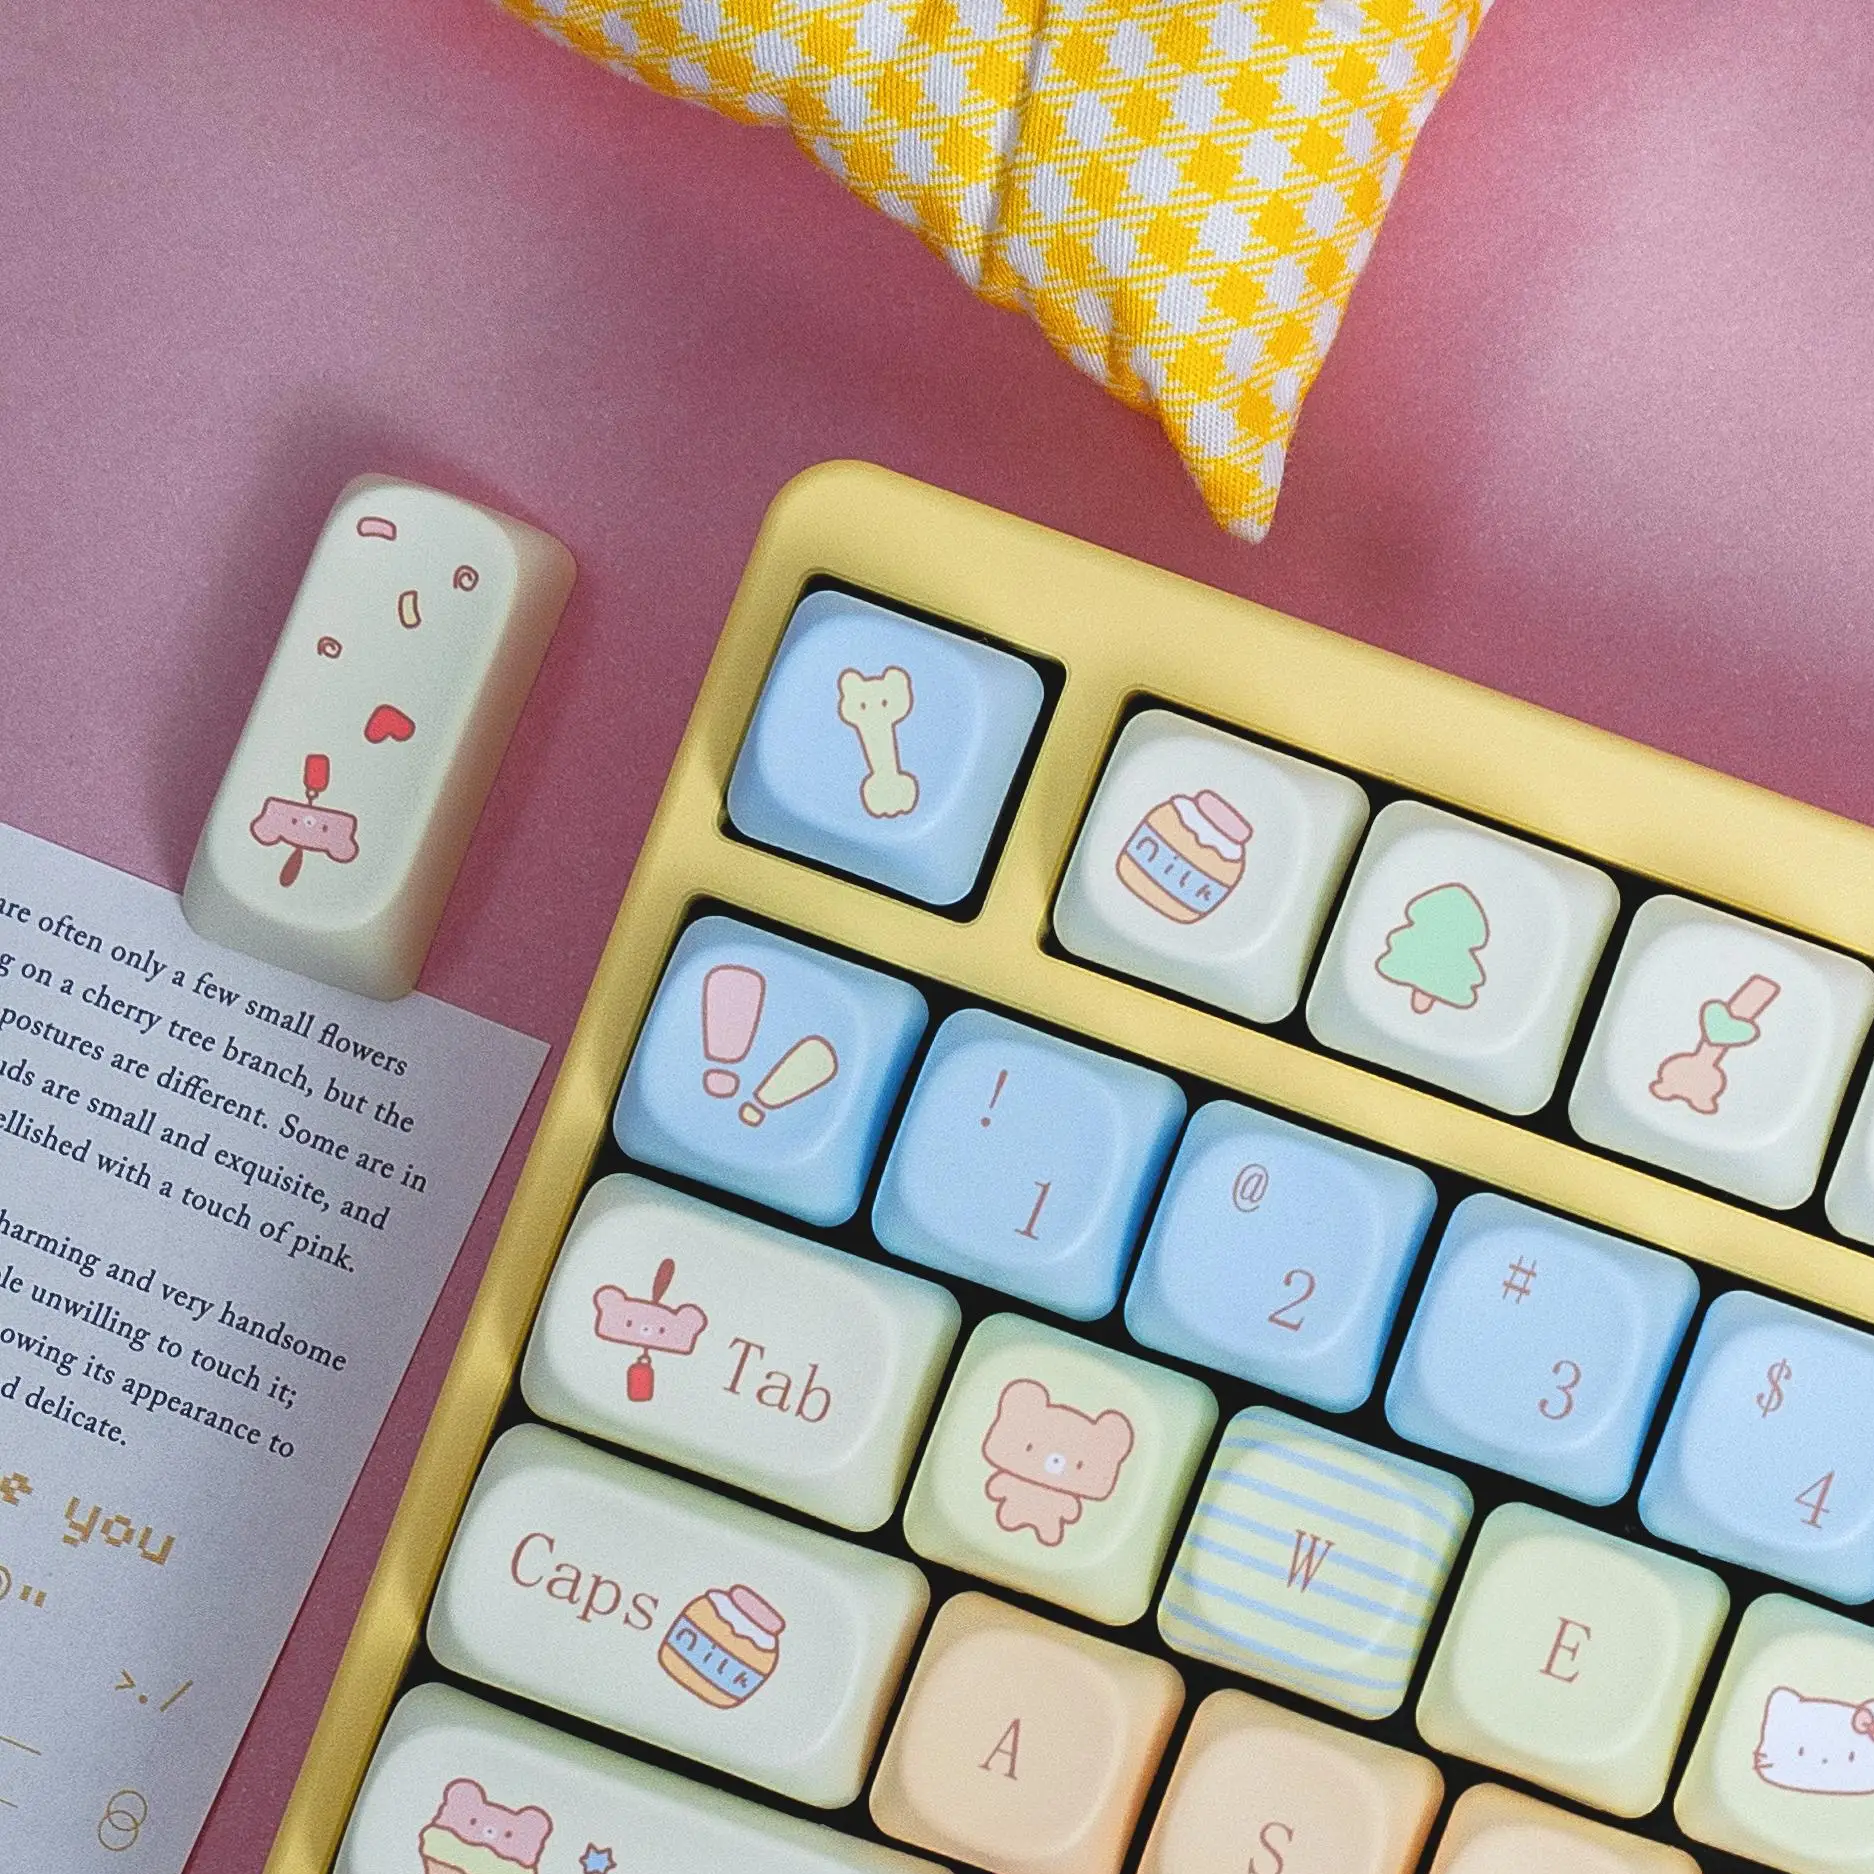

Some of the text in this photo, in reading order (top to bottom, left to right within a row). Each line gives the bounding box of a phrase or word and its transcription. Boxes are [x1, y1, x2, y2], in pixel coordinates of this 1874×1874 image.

[38, 915, 102, 953] often
[111, 946, 167, 983] only
[172, 971, 186, 987] a
[192, 972, 240, 1006] few
[245, 1000, 315, 1038] small
[317, 1023, 407, 1076] flowers
[21, 964, 52, 987] on
[60, 979, 74, 995] a
[82, 984, 162, 1034] cherry
[168, 1020, 215, 1052] tree
[222, 1036, 313, 1097] branch,
[324, 1077, 368, 1114] but
[374, 1101, 414, 1132] the
[0, 1008, 427, 1193] postures are different. Some are in
[981, 1069, 1008, 1127] !
[41, 1079, 80, 1105] are
[87, 1098, 157, 1135] small
[160, 1128, 210, 1157] and
[214, 1149, 329, 1212] exquisite,
[340, 1201, 390, 1230] and
[1232, 1163, 1269, 1212] @
[98, 1153, 151, 1189] with
[159, 1181, 173, 1198] a
[182, 1188, 251, 1230] touch
[260, 1221, 294, 1243] of
[288, 1235, 354, 1272] pink.
[0, 1209, 346, 1371] harming and very handsome
[1269, 1269, 1316, 1331] 2
[1502, 1255, 1537, 1304] #
[31, 1285, 151, 1352] unwilling
[157, 1335, 182, 1358] to
[191, 1349, 260, 1391] touch
[267, 1376, 297, 1409] it;
[723, 1337, 832, 1423] Tab
[0, 1328, 294, 1457] owing its appearance to
[0, 1376, 126, 1446] d delicate.
[1539, 1361, 1582, 1420] 3
[1756, 1358, 1792, 1417] $
[64, 1497, 175, 1566] you
[1795, 1472, 1835, 1529] 4
[511, 1532, 658, 1632] Caps
[1286, 1529, 1336, 1594] W
[1539, 1617, 1592, 1683] E
[979, 1717, 1024, 1781] A
